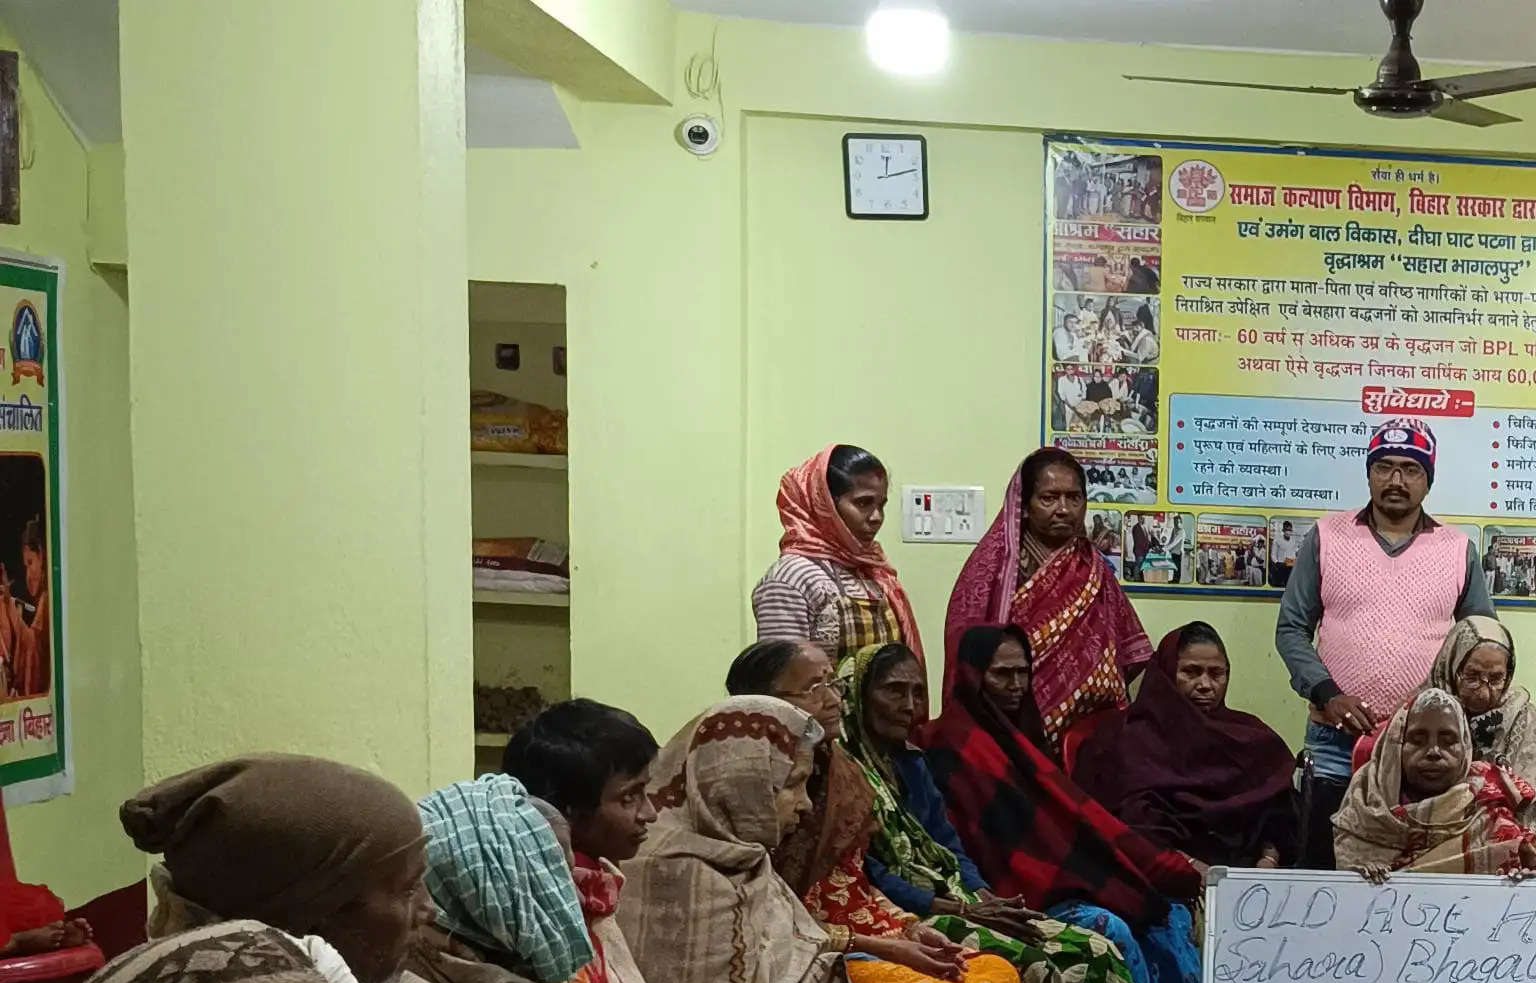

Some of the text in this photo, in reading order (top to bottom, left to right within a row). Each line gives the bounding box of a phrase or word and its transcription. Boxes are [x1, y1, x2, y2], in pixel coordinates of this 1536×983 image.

[1229, 184, 1276, 205] समाज
[1283, 186, 1341, 209] कल्याण
[1409, 187, 1450, 215] बिहार
[1456, 196, 1505, 218] सरकार
[1237, 218, 1263, 238] एवं
[1265, 218, 1303, 240] उमंग
[1346, 221, 1402, 246] विकास,
[1408, 224, 1442, 247] दीघा
[1447, 233, 1474, 248] घाट
[1478, 234, 1516, 250] पटना
[1324, 252, 1384, 274] वृद्धाश्रम
[1215, 278, 1257, 291] सरकार
[1262, 280, 1286, 294] द्वारा
[1290, 279, 1350, 296] माता-पिता
[1355, 282, 1375, 300] एवं
[1379, 282, 1413, 300] वरिष्ठ
[1417, 284, 1467, 302] नागरिकों
[1471, 287, 1488, 302] को
[1175, 296, 1223, 313] निराश्रित
[1228, 297, 1269, 318] उपेक्षित
[1279, 302, 1297, 320] एवं
[1302, 301, 1345, 320] बेसहारा
[1401, 305, 1418, 322] को
[1423, 309, 1482, 326] आत्मनिर्भर
[1238, 328, 1257, 344] 60
[1264, 327, 1287, 345] वर्ष
[1310, 330, 1355, 349] अधिक
[1361, 335, 1379, 350] उम्र
[1386, 332, 1400, 350] के
[1405, 337, 1455, 357] वृद्धजन
[1459, 337, 1477, 353] जो
[1483, 341, 1518, 356] BPL
[1239, 357, 1280, 372] अथवा
[1285, 356, 1307, 378] ऐसे
[1314, 361, 1363, 379] वृद्धजन
[1368, 360, 1414, 379] जिनका
[1421, 363, 1467, 382] वार्षिक
[1472, 370, 1501, 382] आय
[1194, 415, 1238, 433] वृद्धजनों
[1242, 418, 1258, 431] की
[1263, 418, 1297, 436] सम्पूर्ण
[1302, 422, 1346, 435] देखभाल
[1351, 421, 1367, 435] की
[1227, 440, 1243, 456] एवं
[1296, 442, 1308, 456] के
[1312, 443, 1336, 459] लिए
[1194, 459, 1214, 474] रहने
[1219, 460, 1234, 474] की
[1193, 481, 1213, 496] प्रति
[1218, 482, 1237, 497] दिन
[1242, 482, 1266, 497] खाने
[1270, 484, 1285, 498] की
[1506, 480, 1532, 491] समय
[1505, 498, 1524, 512] प्रति
[1234, 884, 1337, 931] OLD
[1357, 888, 1470, 935] AGE
